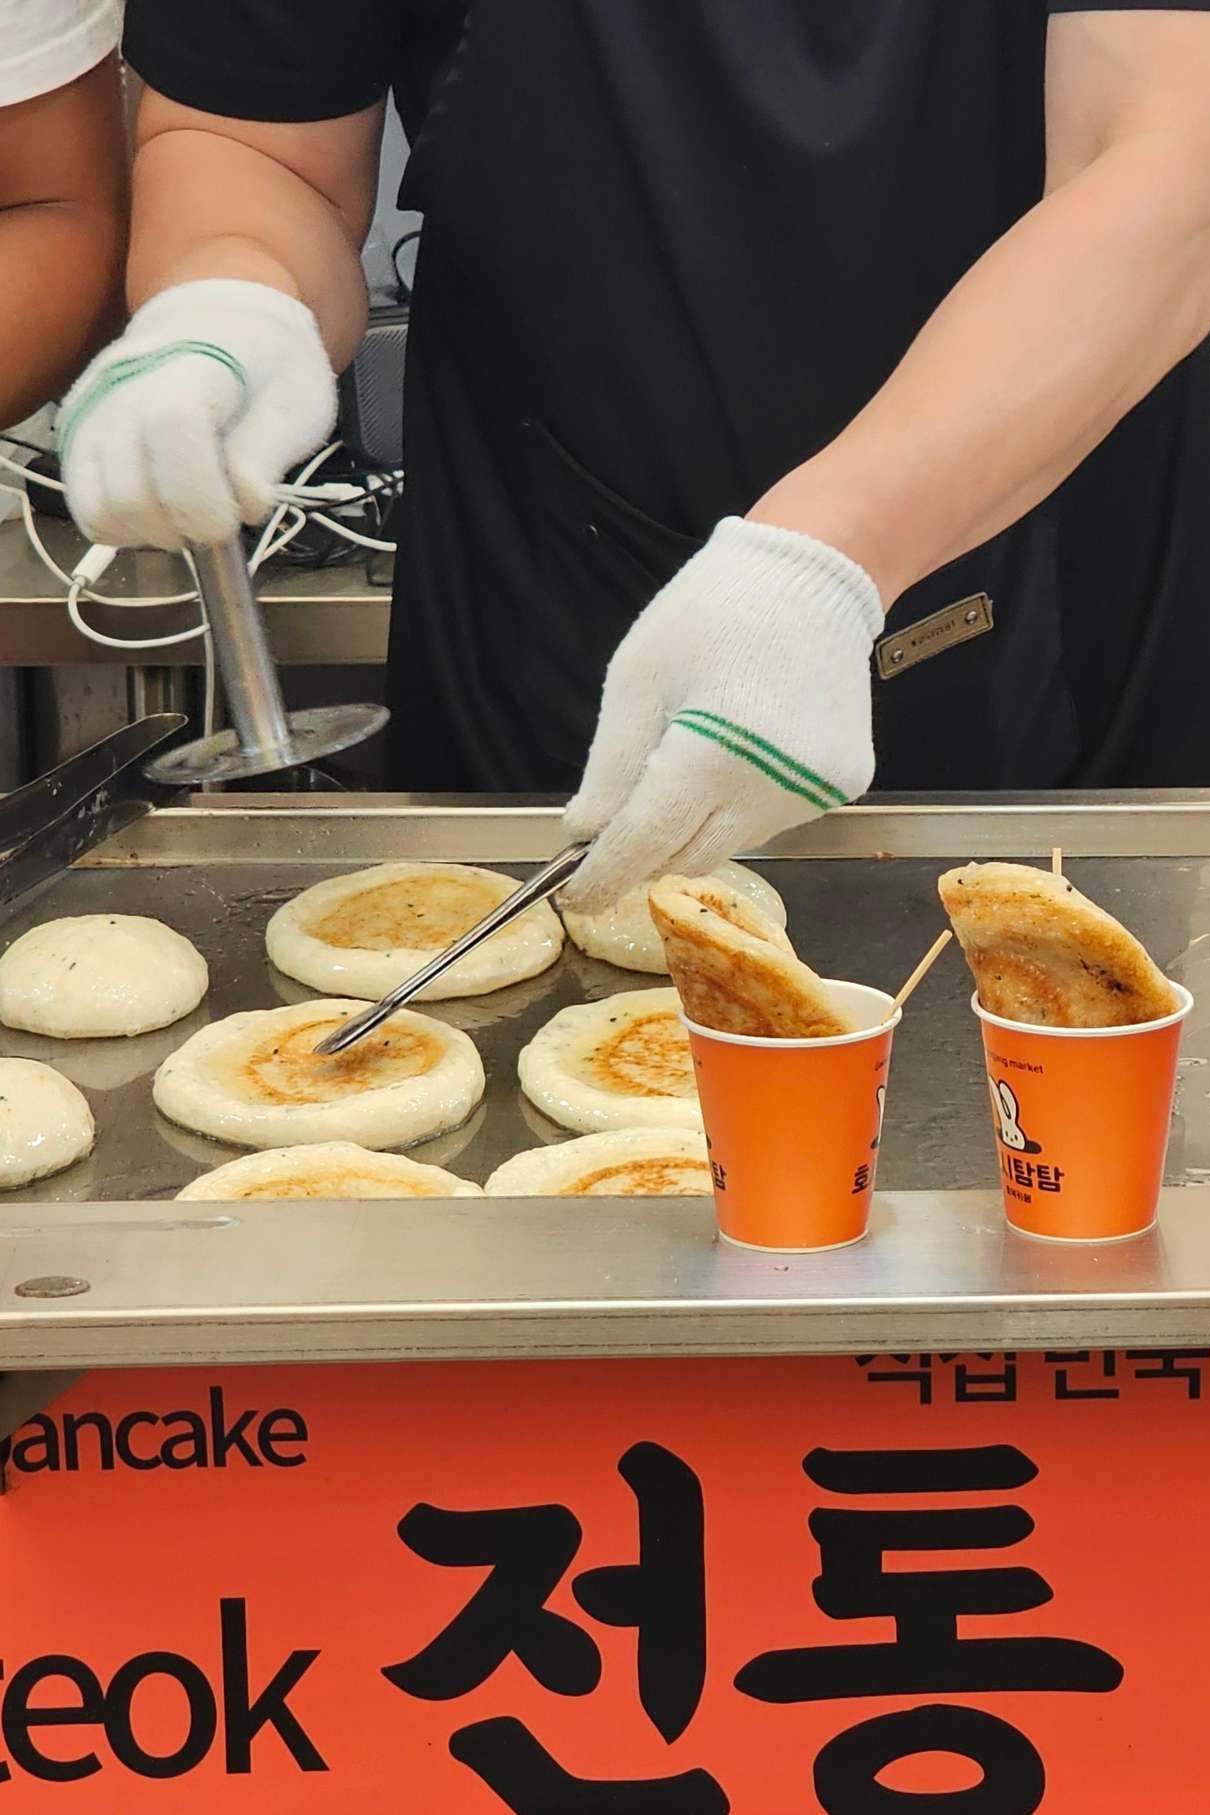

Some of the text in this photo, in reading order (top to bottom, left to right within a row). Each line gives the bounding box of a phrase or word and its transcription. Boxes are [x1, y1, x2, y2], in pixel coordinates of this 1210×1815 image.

[1009, 1058, 1044, 1074] market
[0, 1597, 330, 1783] eok
[380, 1441, 1124, 1815] 전통
